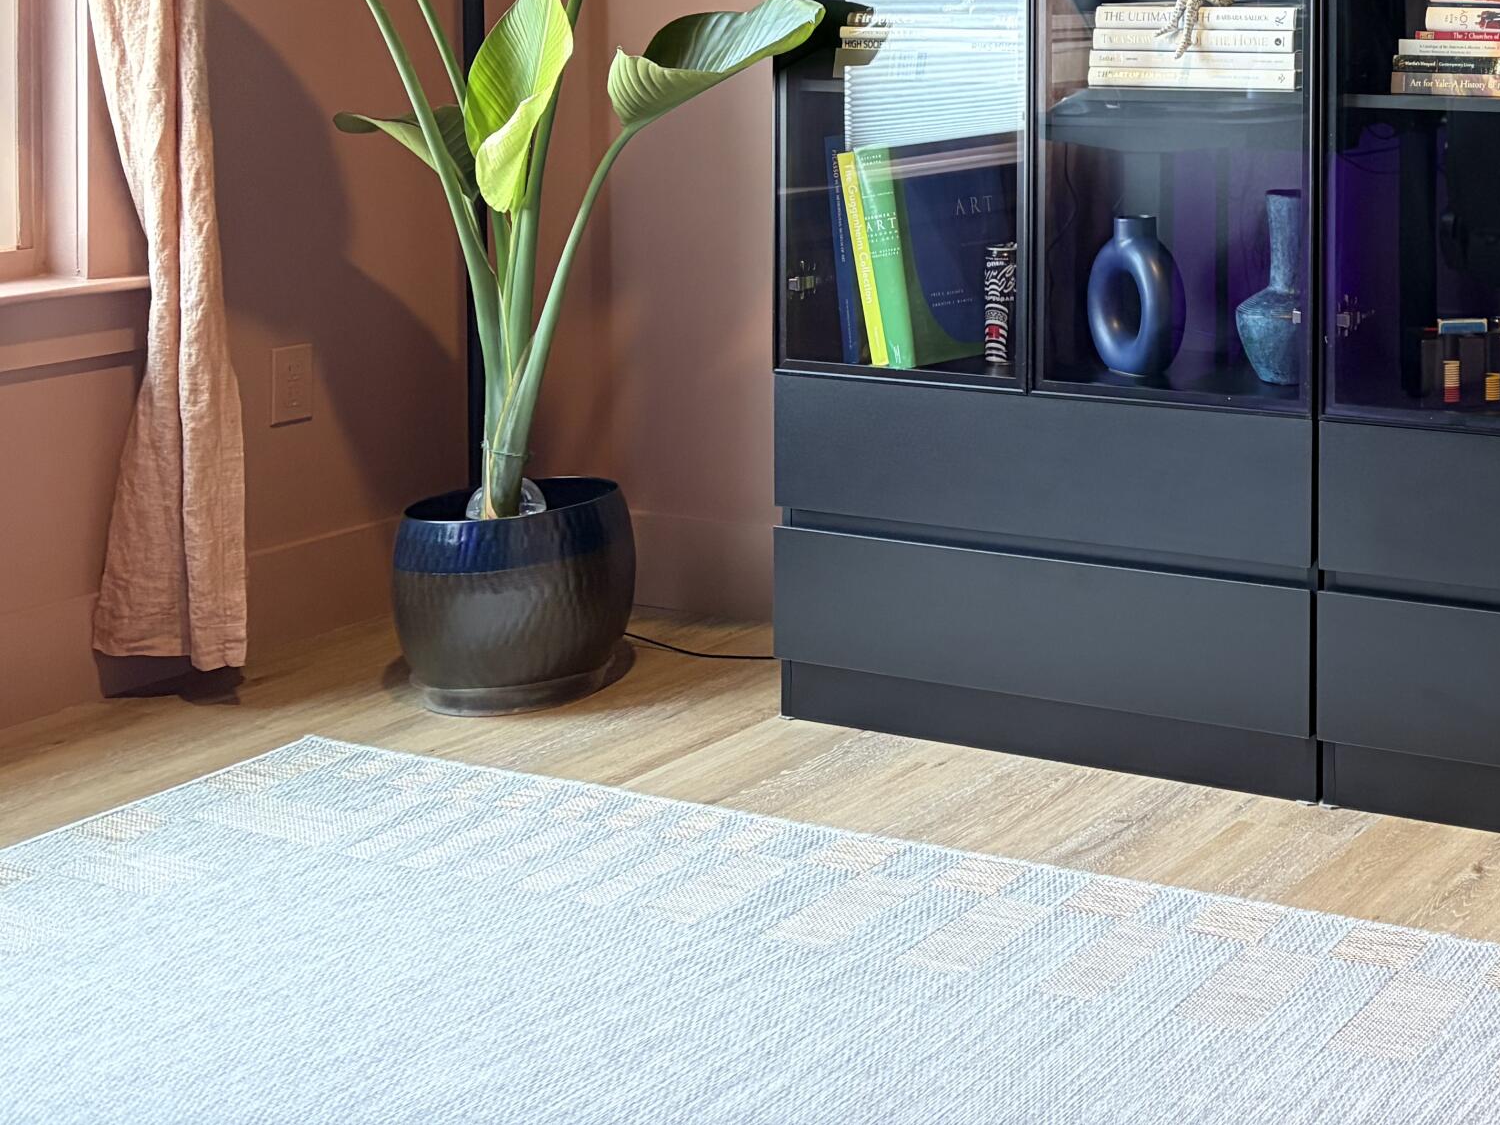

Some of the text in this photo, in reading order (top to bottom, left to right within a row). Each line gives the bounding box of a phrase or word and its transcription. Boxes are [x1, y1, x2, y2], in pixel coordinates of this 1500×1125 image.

[1104, 11, 1125, 22] THE
[1127, 11, 1173, 22] ULTIMAT
[1459, 10, 1468, 29] JOY
[844, 39, 862, 49] HIGH
[1410, 79, 1422, 88] Art
[1423, 79, 1434, 88] for
[1434, 79, 1451, 89] Yale:
[1460, 80, 1486, 92] History
[955, 195, 993, 216] ART
[866, 217, 897, 232] ART
[844, 163, 873, 304] The Guggenheim Collection
